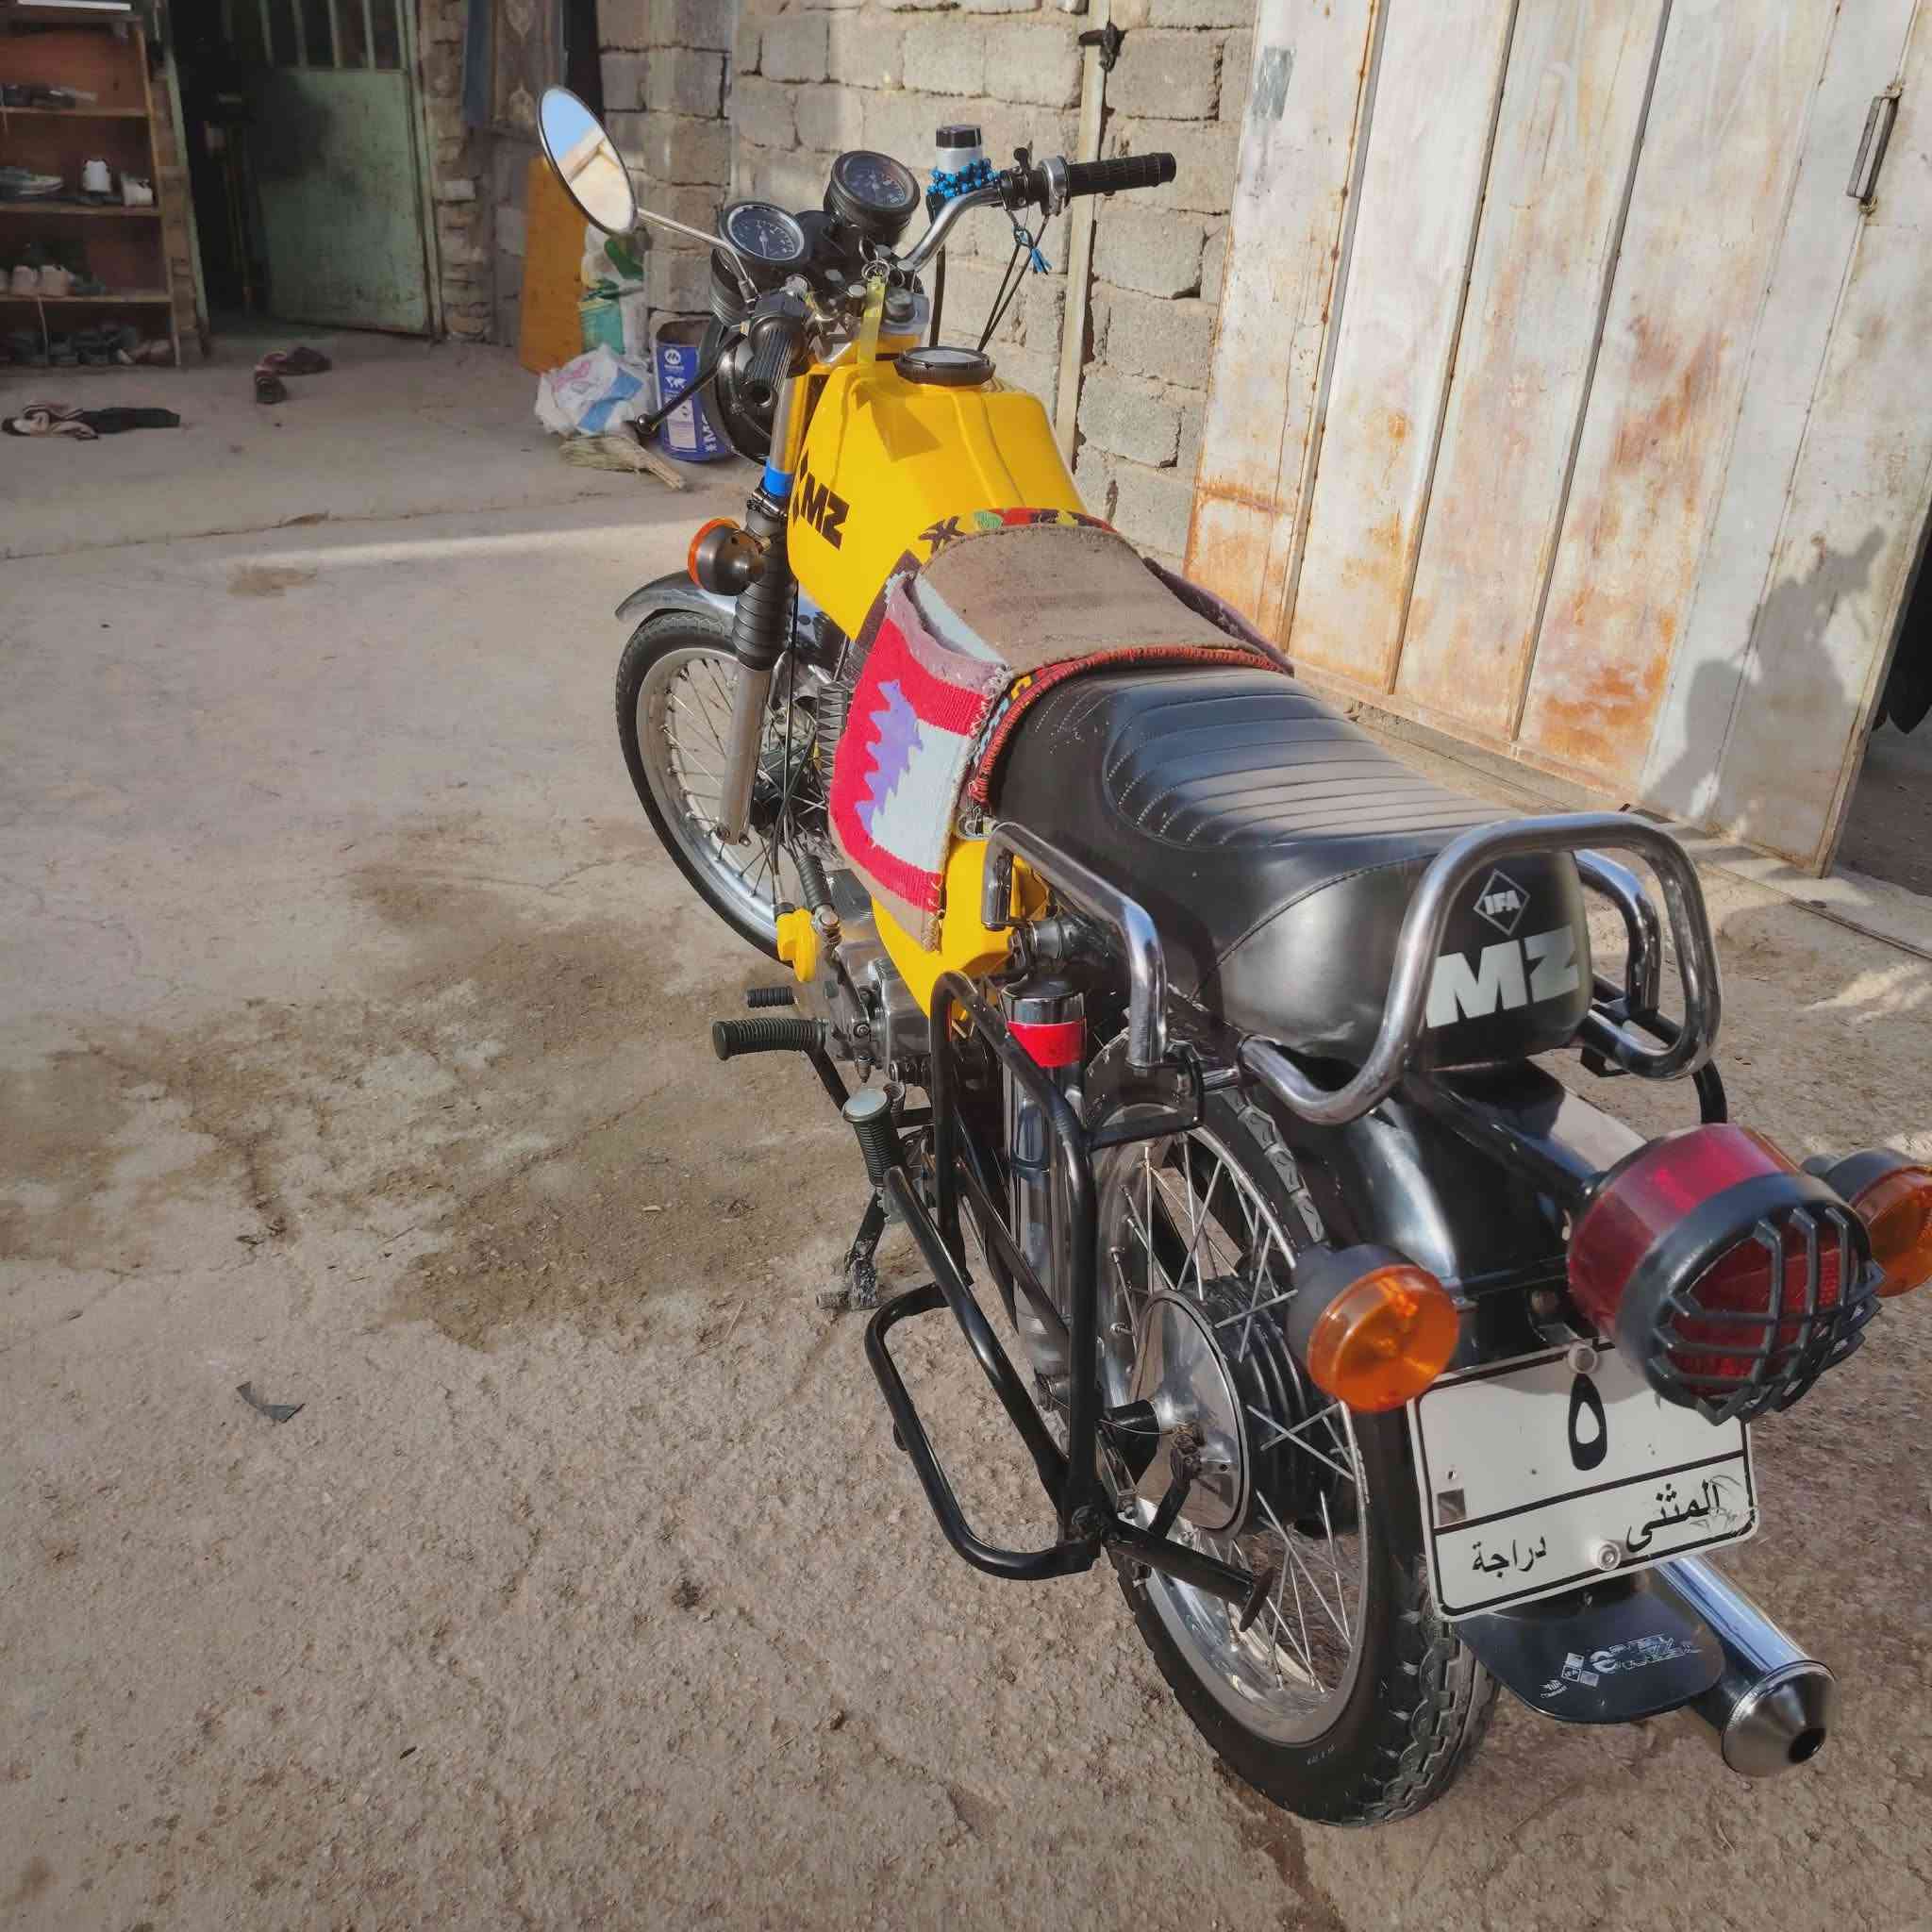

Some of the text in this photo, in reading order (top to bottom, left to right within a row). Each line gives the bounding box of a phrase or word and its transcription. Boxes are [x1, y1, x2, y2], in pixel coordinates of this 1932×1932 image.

[801, 471, 850, 551] MZ
[1484, 890, 1521, 915] IFA
[1425, 925, 1580, 1028] MZ
[1472, 1478, 1720, 1578] المثنى دراجة
